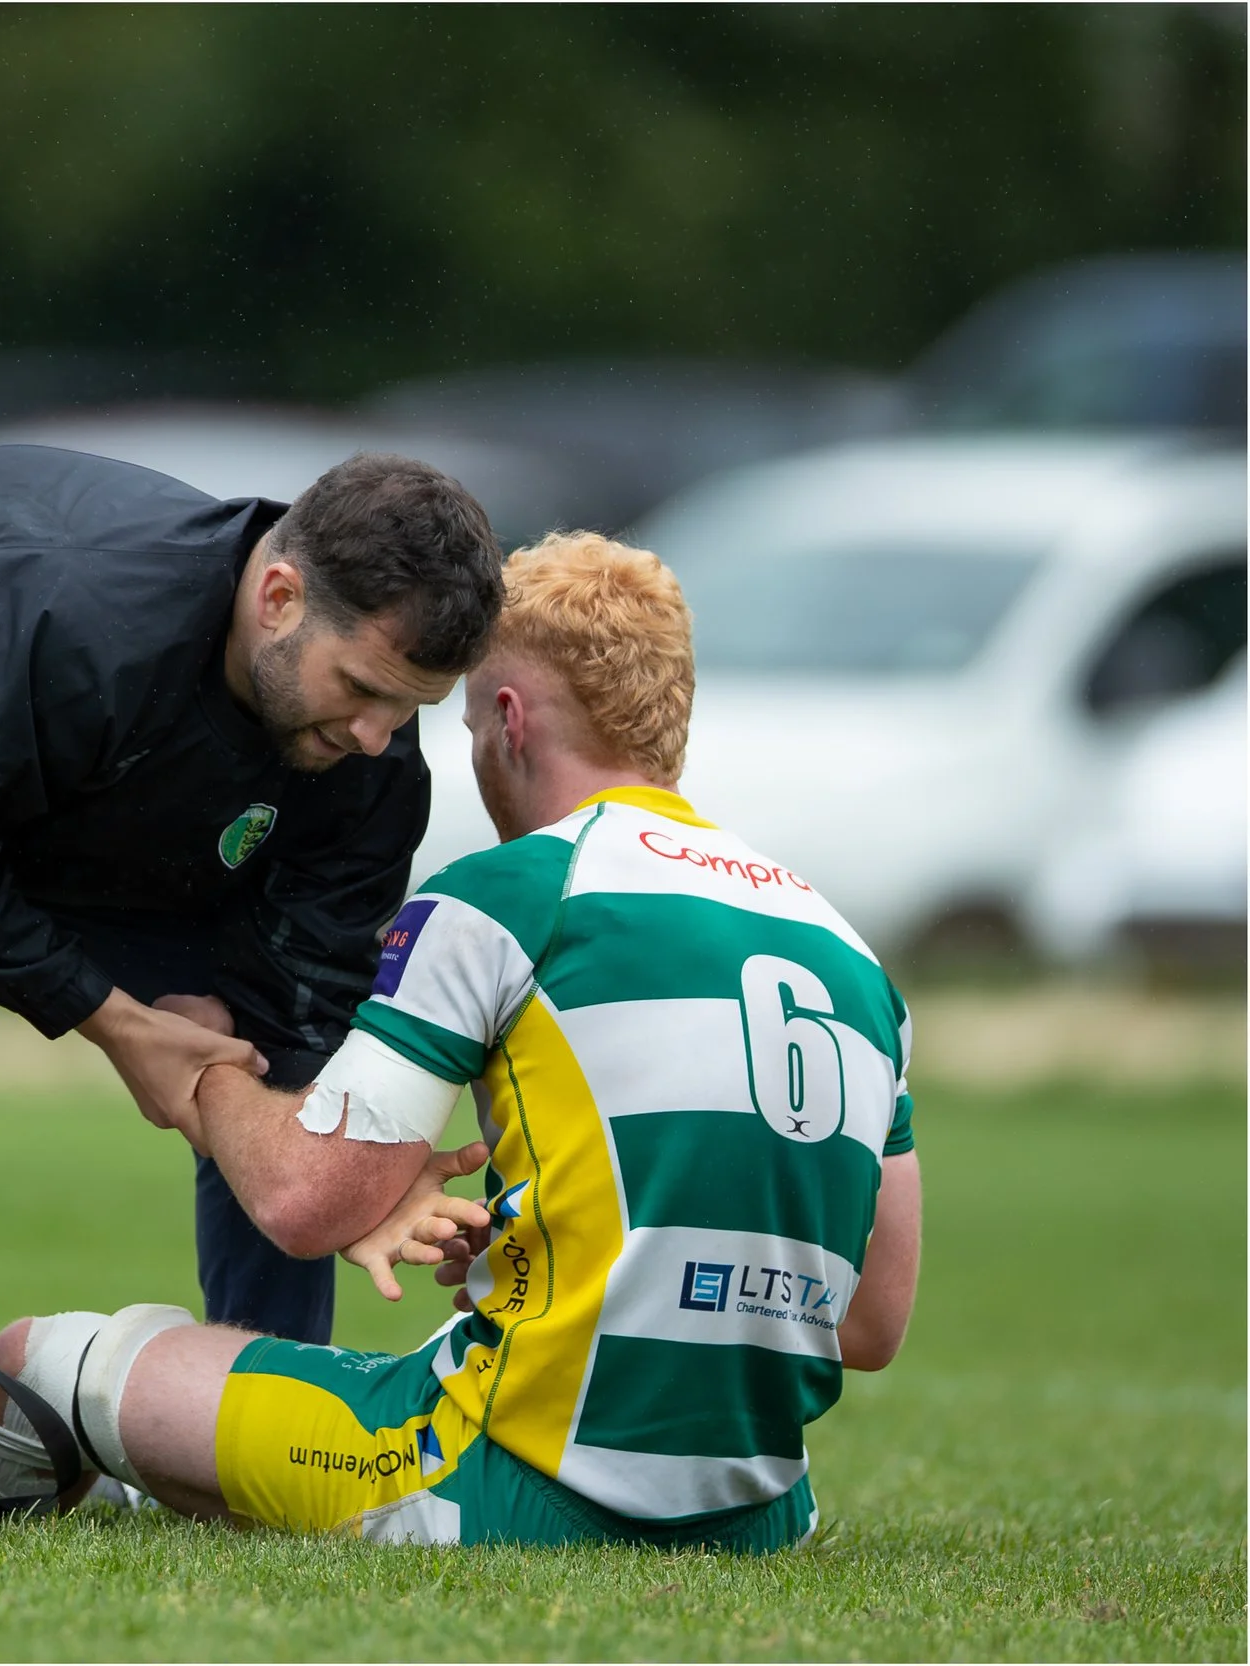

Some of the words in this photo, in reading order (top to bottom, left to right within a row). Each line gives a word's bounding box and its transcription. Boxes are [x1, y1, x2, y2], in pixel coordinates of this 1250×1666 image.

[740, 954, 847, 1143] 6
[502, 1234, 531, 1314] OORE
[738, 1265, 793, 1304] LTS
[736, 1301, 788, 1320] Chartered
